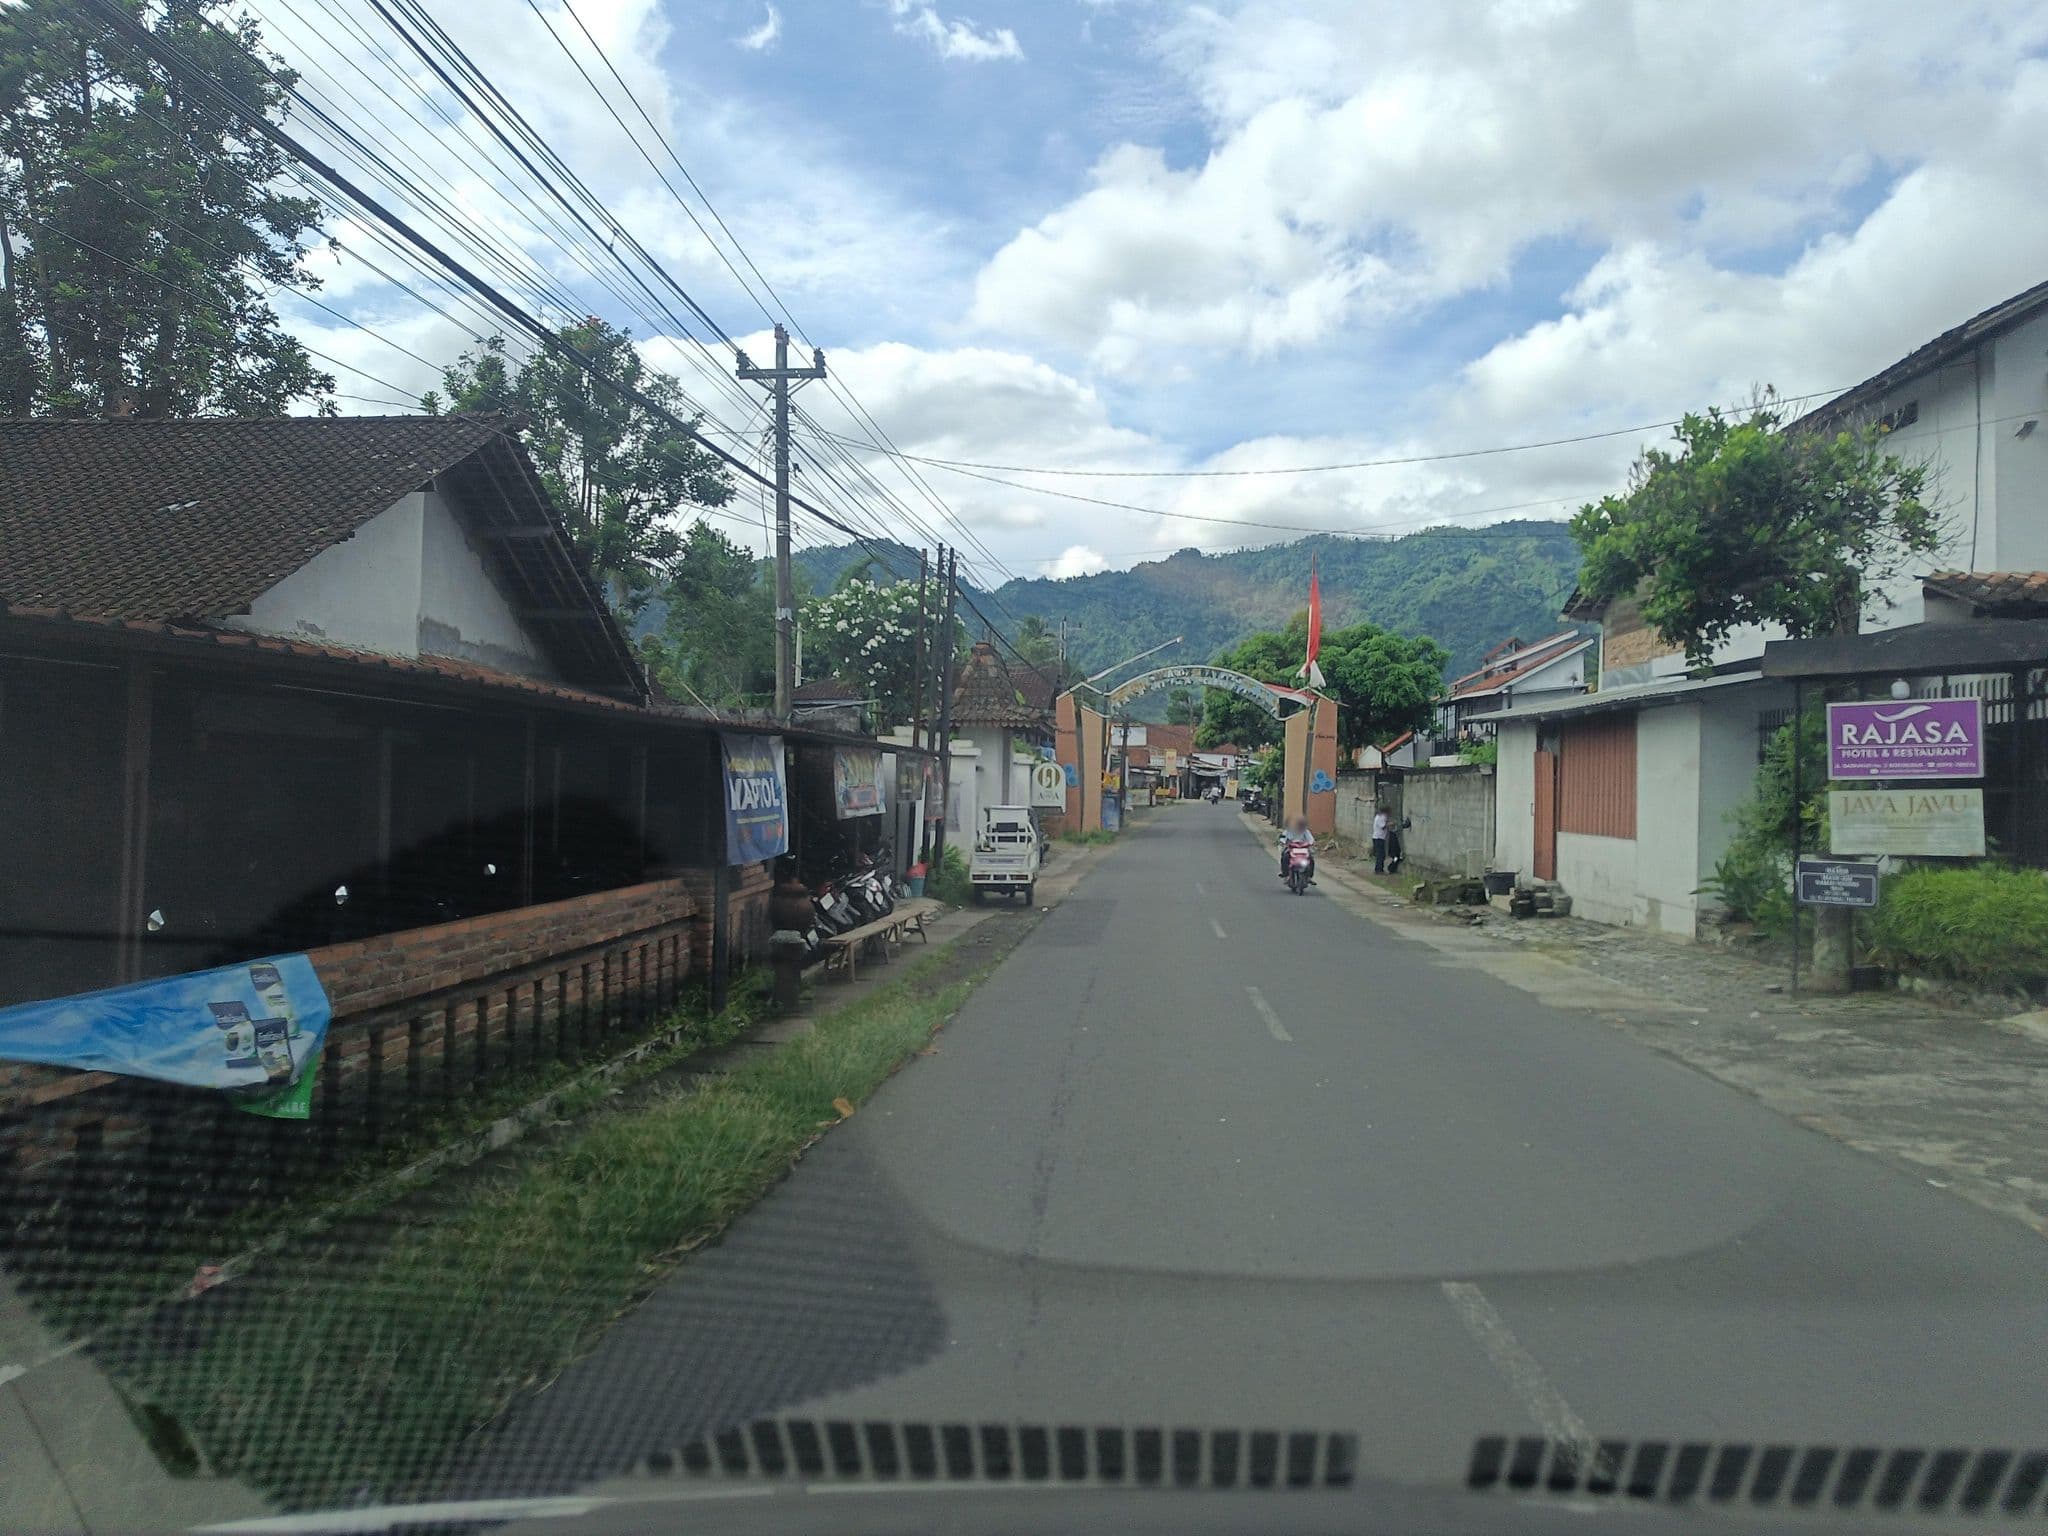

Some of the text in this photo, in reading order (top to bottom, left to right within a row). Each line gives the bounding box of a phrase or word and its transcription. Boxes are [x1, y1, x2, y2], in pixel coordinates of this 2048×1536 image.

[1842, 721, 1968, 745] RAJASA
[1841, 747, 1968, 758] HOTEL & RESTAURANT
[1841, 794, 1968, 816] JAVA JAVU
